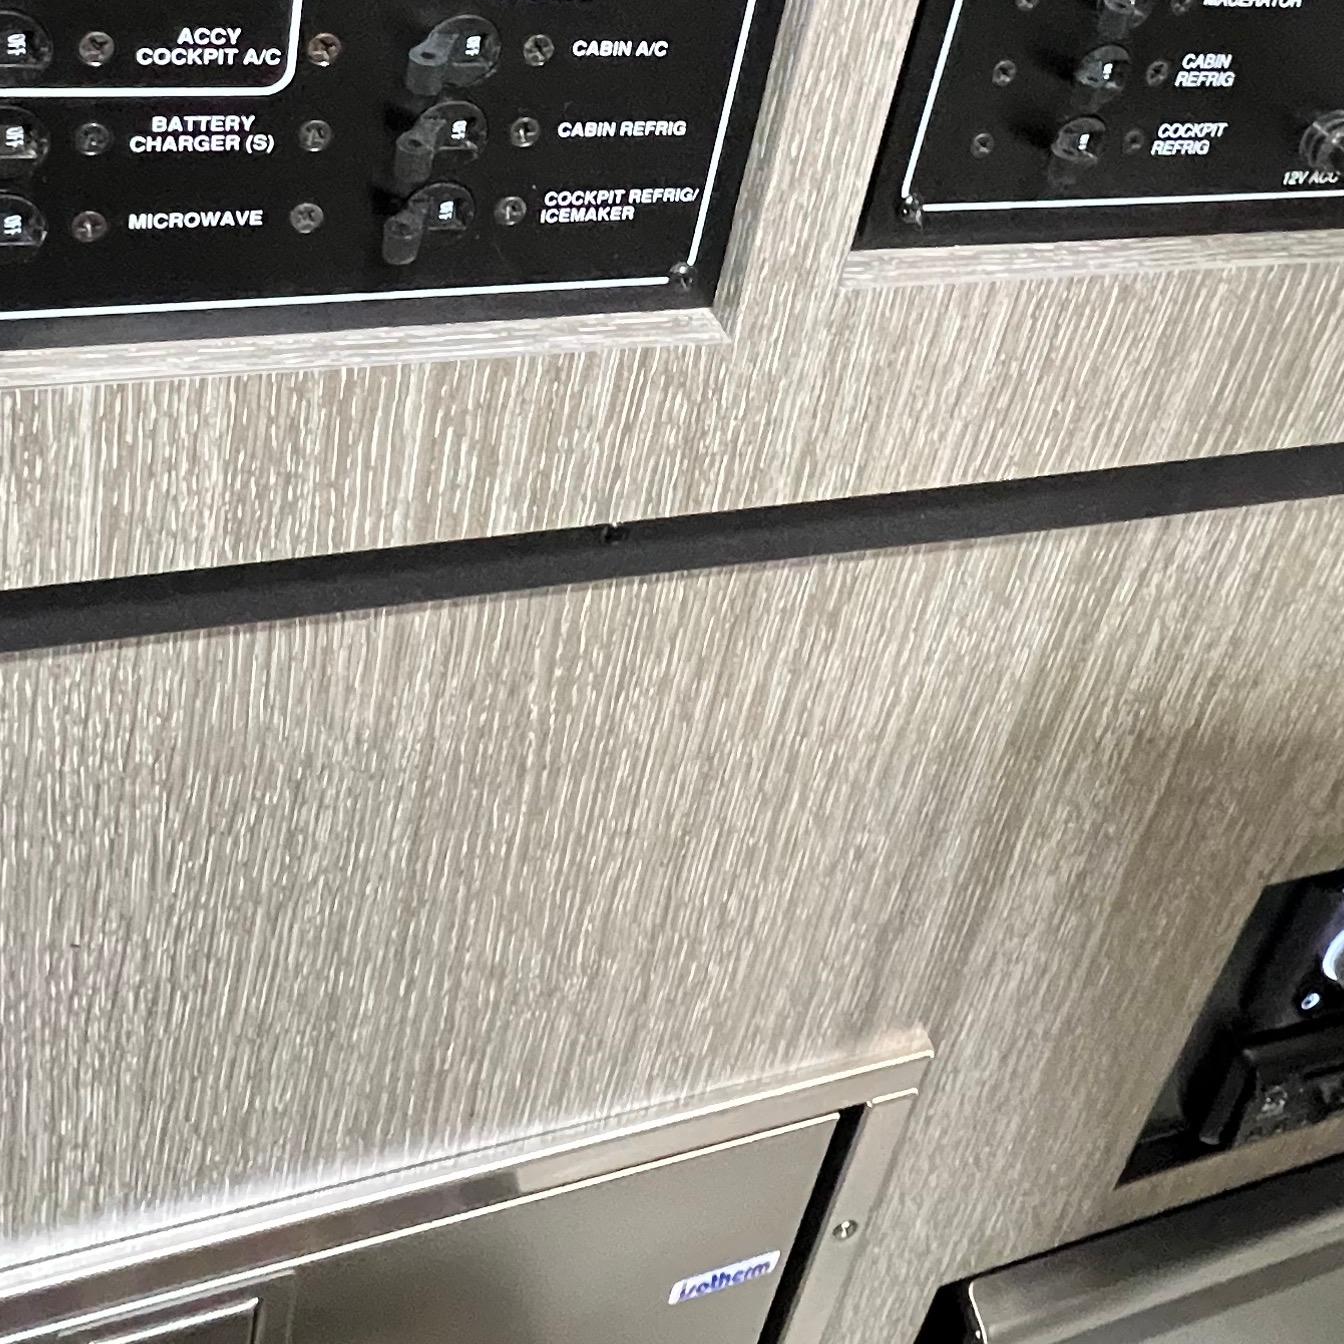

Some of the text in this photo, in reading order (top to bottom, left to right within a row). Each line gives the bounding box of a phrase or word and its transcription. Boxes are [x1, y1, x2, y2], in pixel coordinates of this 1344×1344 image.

[177, 28, 242, 46] ACCY
[136, 47, 282, 66] COCKPIT A/C
[573, 41, 668, 57] CABIN A/C
[1182, 54, 1232, 69] CABIN
[1175, 72, 1235, 87] REFRIG
[152, 115, 256, 133] BATTERY
[558, 121, 687, 138] CABIN REFRIG
[1158, 123, 1228, 138] COCKPIT
[129, 134, 274, 154] CHARGER (S)
[1151, 140, 1210, 155] REFRIG
[544, 187, 700, 206] COCKPIT REFRIG/
[128, 210, 263, 230] MICROWAVE
[540, 206, 635, 224] ICEMAKER
[680, 1262, 770, 1298] isotherm
